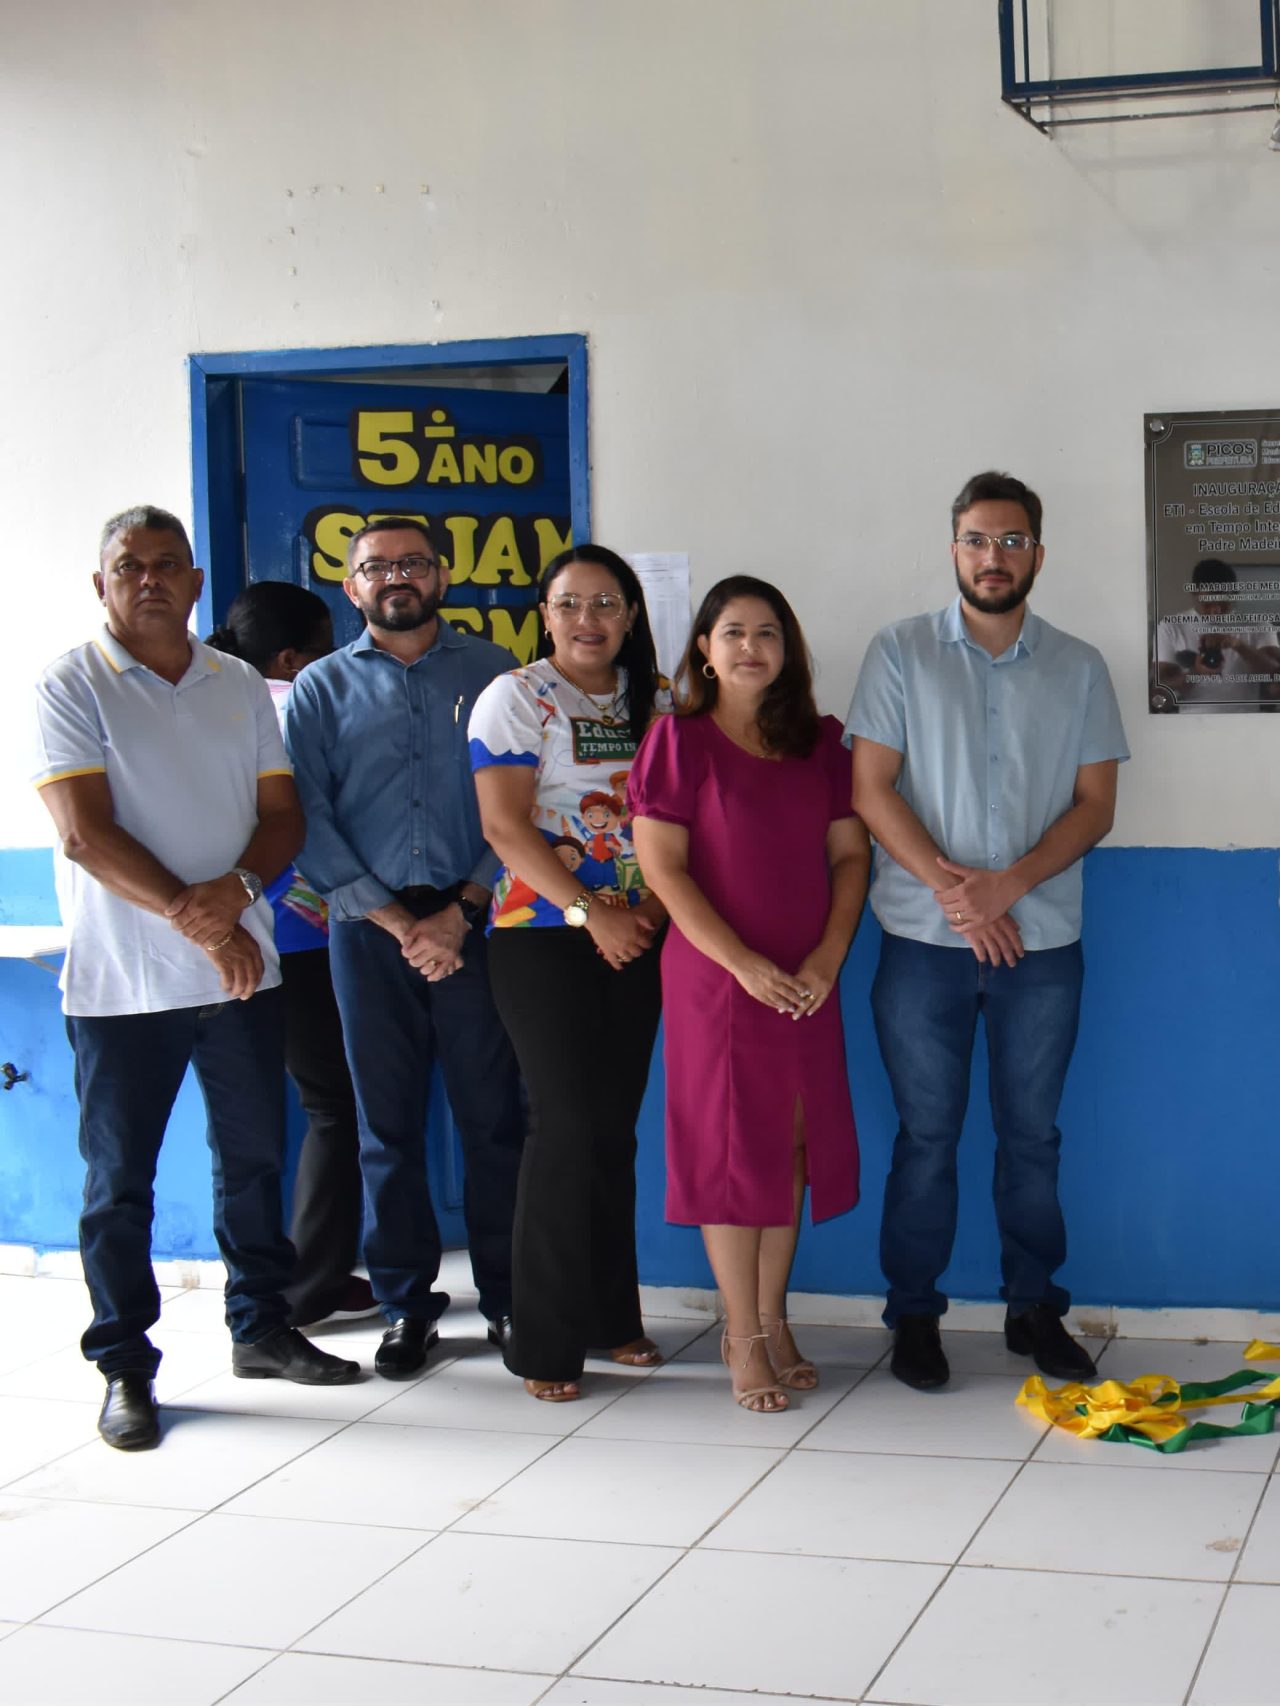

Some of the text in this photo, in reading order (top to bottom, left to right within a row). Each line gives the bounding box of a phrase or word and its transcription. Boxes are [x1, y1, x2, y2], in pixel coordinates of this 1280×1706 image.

[1206, 443, 1254, 455] PICOS
[426, 443, 535, 485] ANO
[1163, 503, 1185, 517] ETI
[1199, 502, 1239, 516] Escola
[1244, 502, 1259, 514] de
[1185, 524, 1205, 534] em
[1209, 521, 1250, 535] Tempo
[1198, 539, 1235, 552] Padre
[1200, 581, 1246, 592] MARQUES
[1247, 581, 1258, 591] DE
[1164, 614, 1199, 625] NOEMIA
[1201, 614, 1244, 624] MOREIRA
[1245, 613, 1280, 624] FEITOSA
[580, 742, 622, 752] TEMPO
